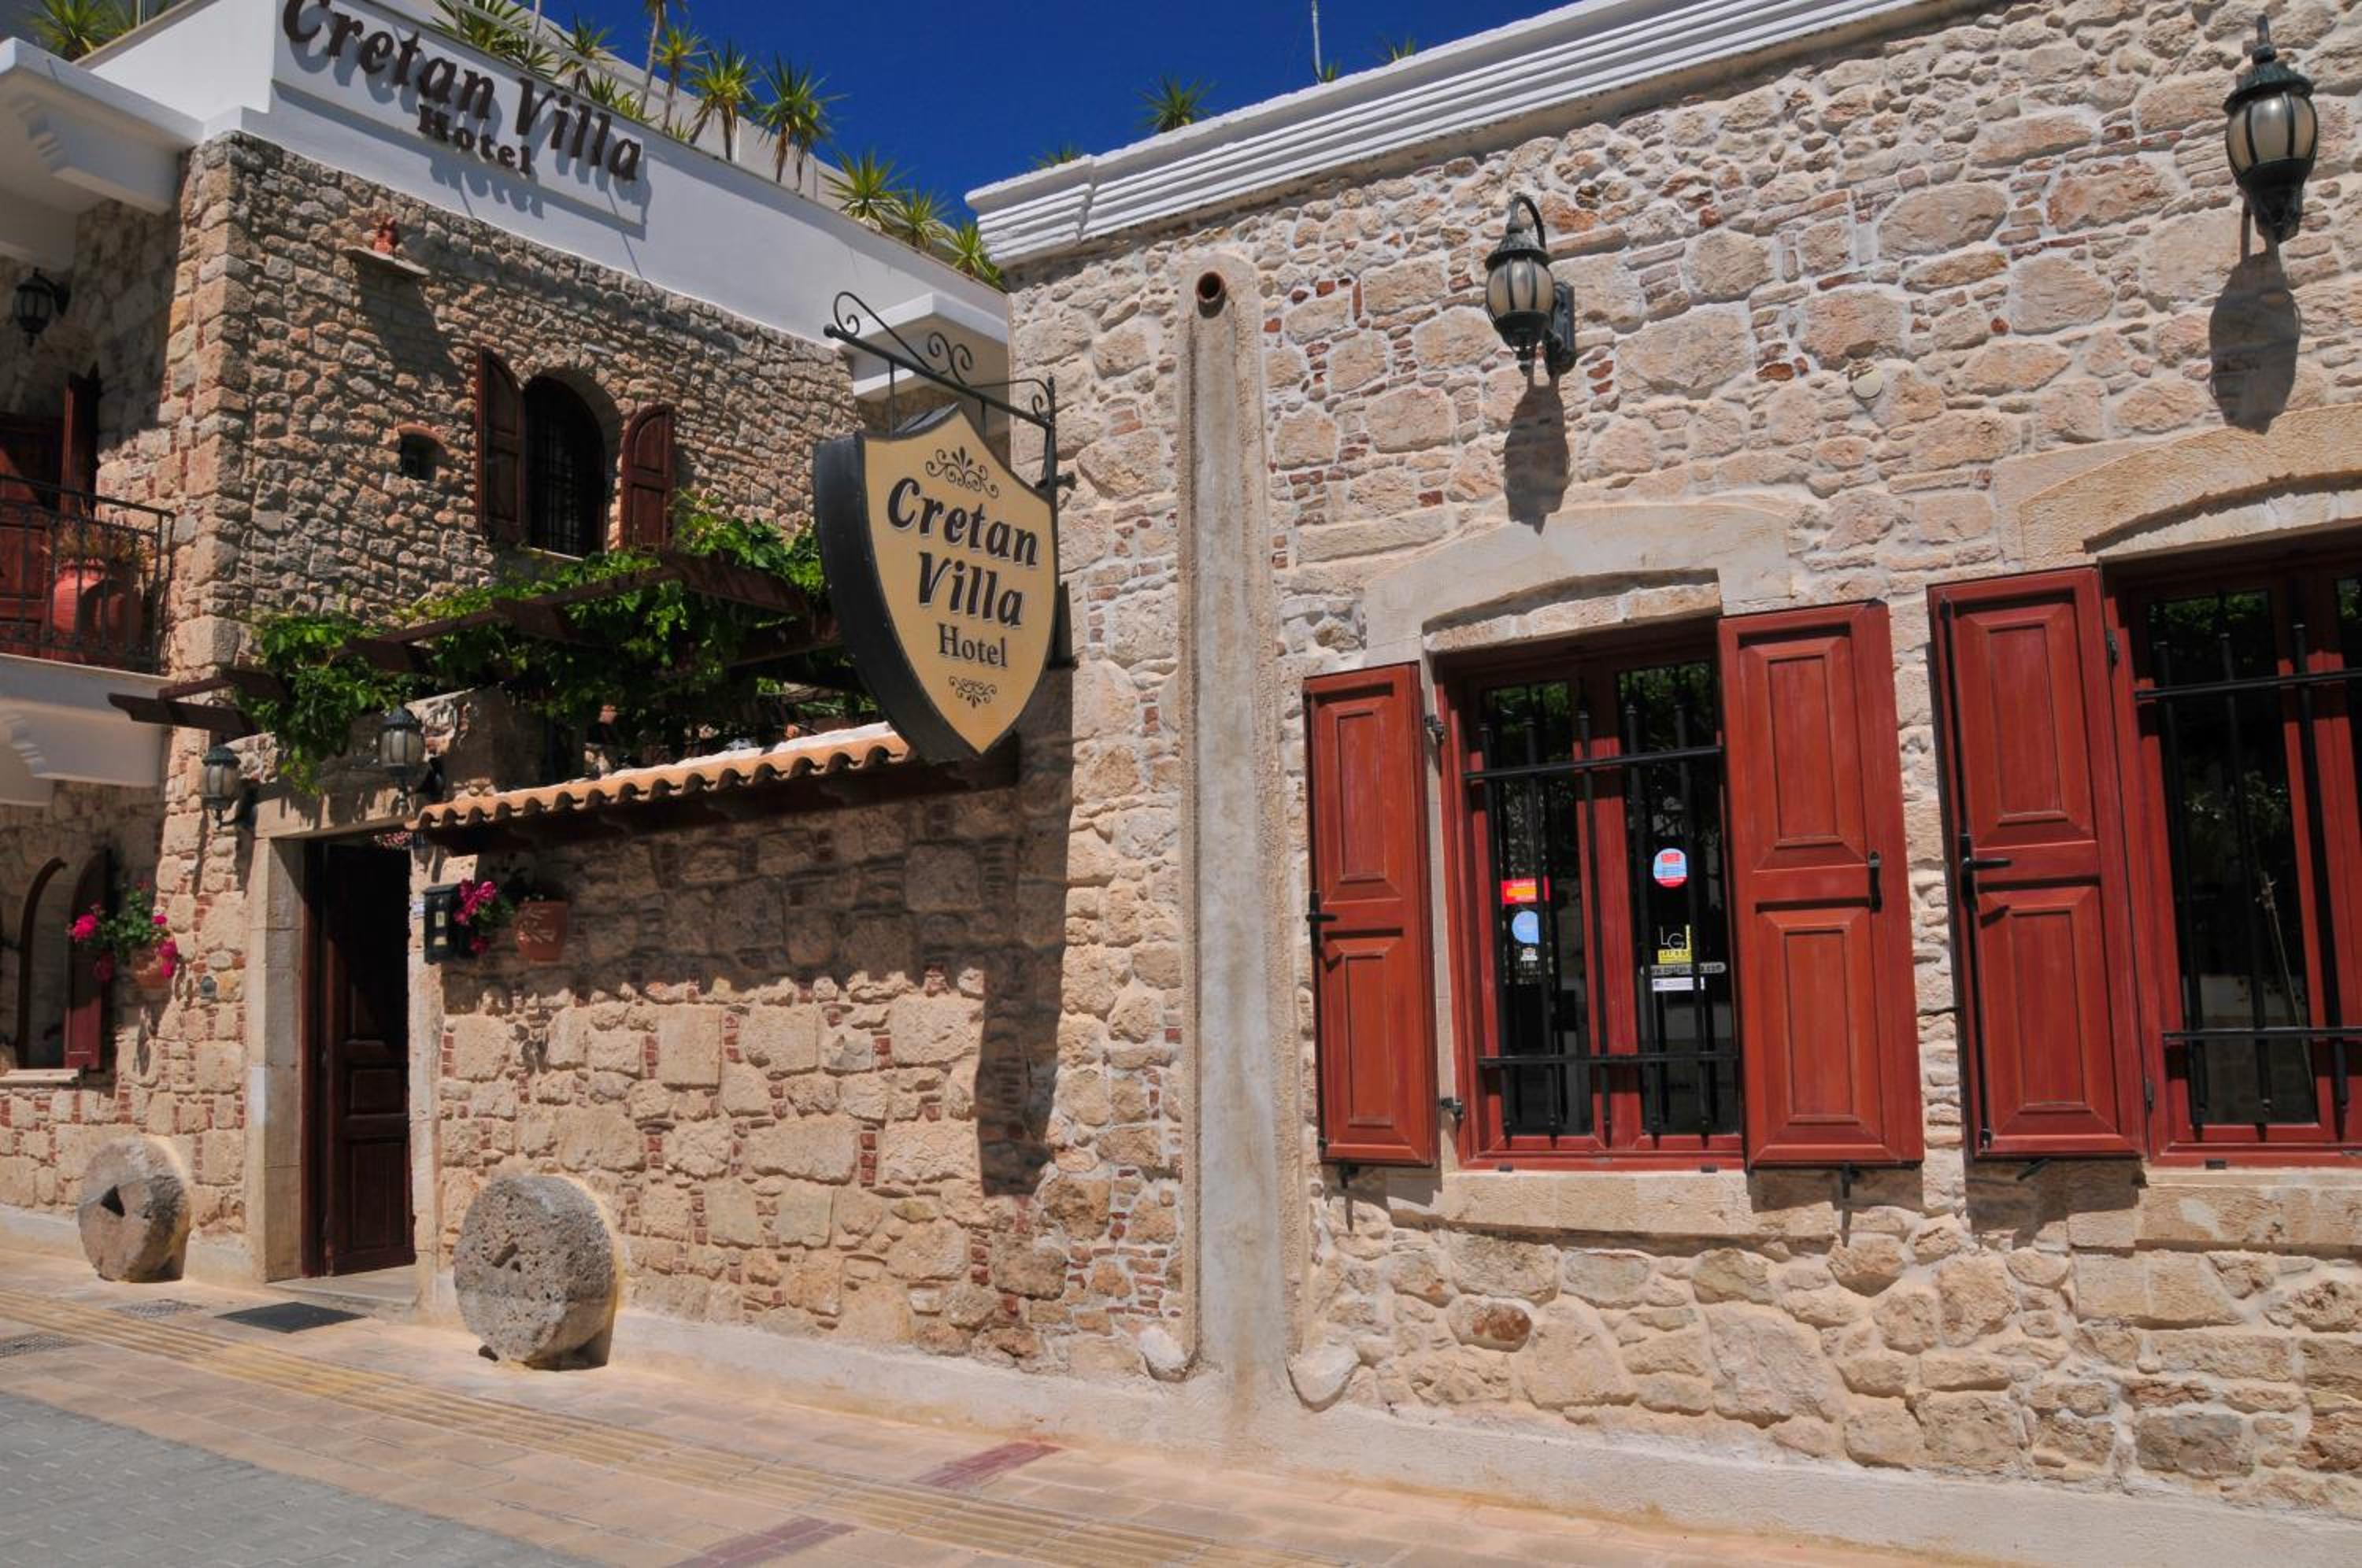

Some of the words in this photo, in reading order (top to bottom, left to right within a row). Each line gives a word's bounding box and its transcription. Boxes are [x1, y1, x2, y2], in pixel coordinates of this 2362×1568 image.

[283, 0, 494, 120] Cretan
[516, 77, 642, 181] Villa
[417, 104, 531, 176] Hotel
[887, 477, 1037, 567] Cretan
[918, 552, 1025, 627] Villa
[938, 623, 1009, 668] Hotel
